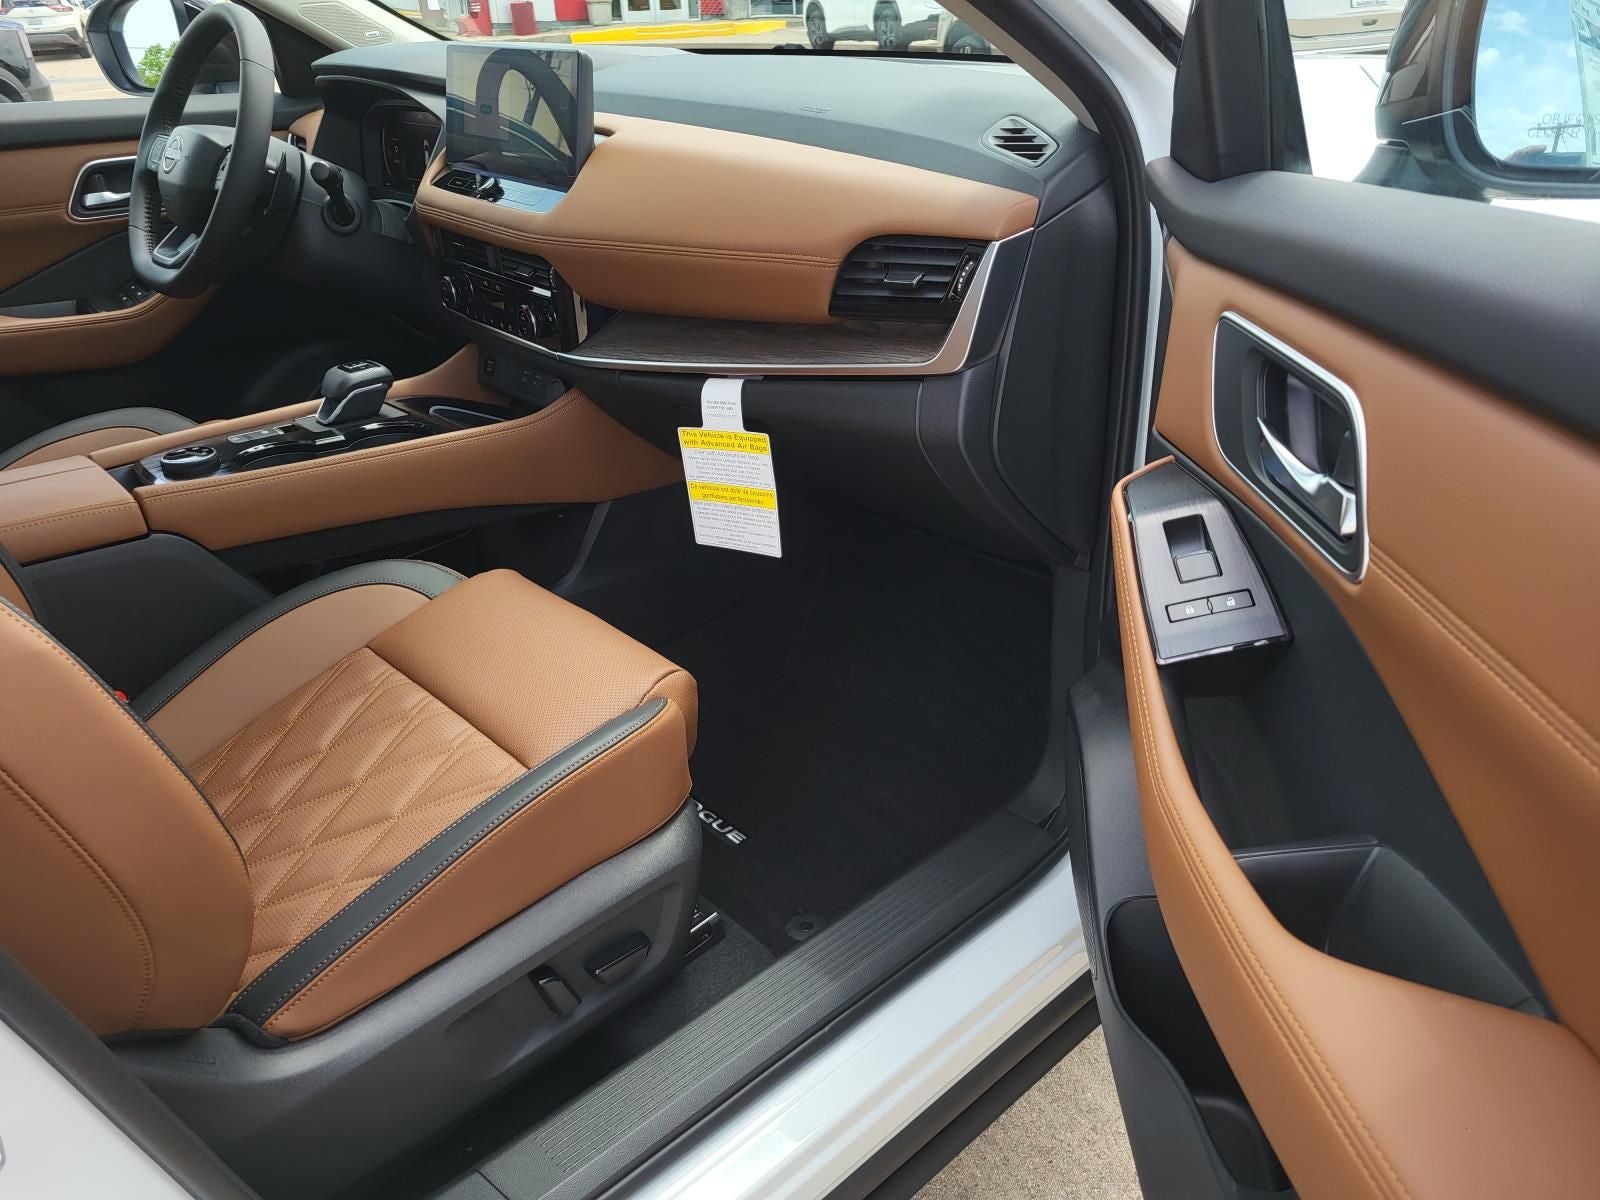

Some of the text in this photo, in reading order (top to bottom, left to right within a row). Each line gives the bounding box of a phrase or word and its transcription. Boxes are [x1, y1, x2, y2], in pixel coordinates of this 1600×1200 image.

[682, 430, 697, 438] This
[699, 431, 724, 440] Vehicle
[734, 434, 767, 444] Equipped
[701, 440, 735, 449] Advanced
[750, 443, 767, 452] Bags
